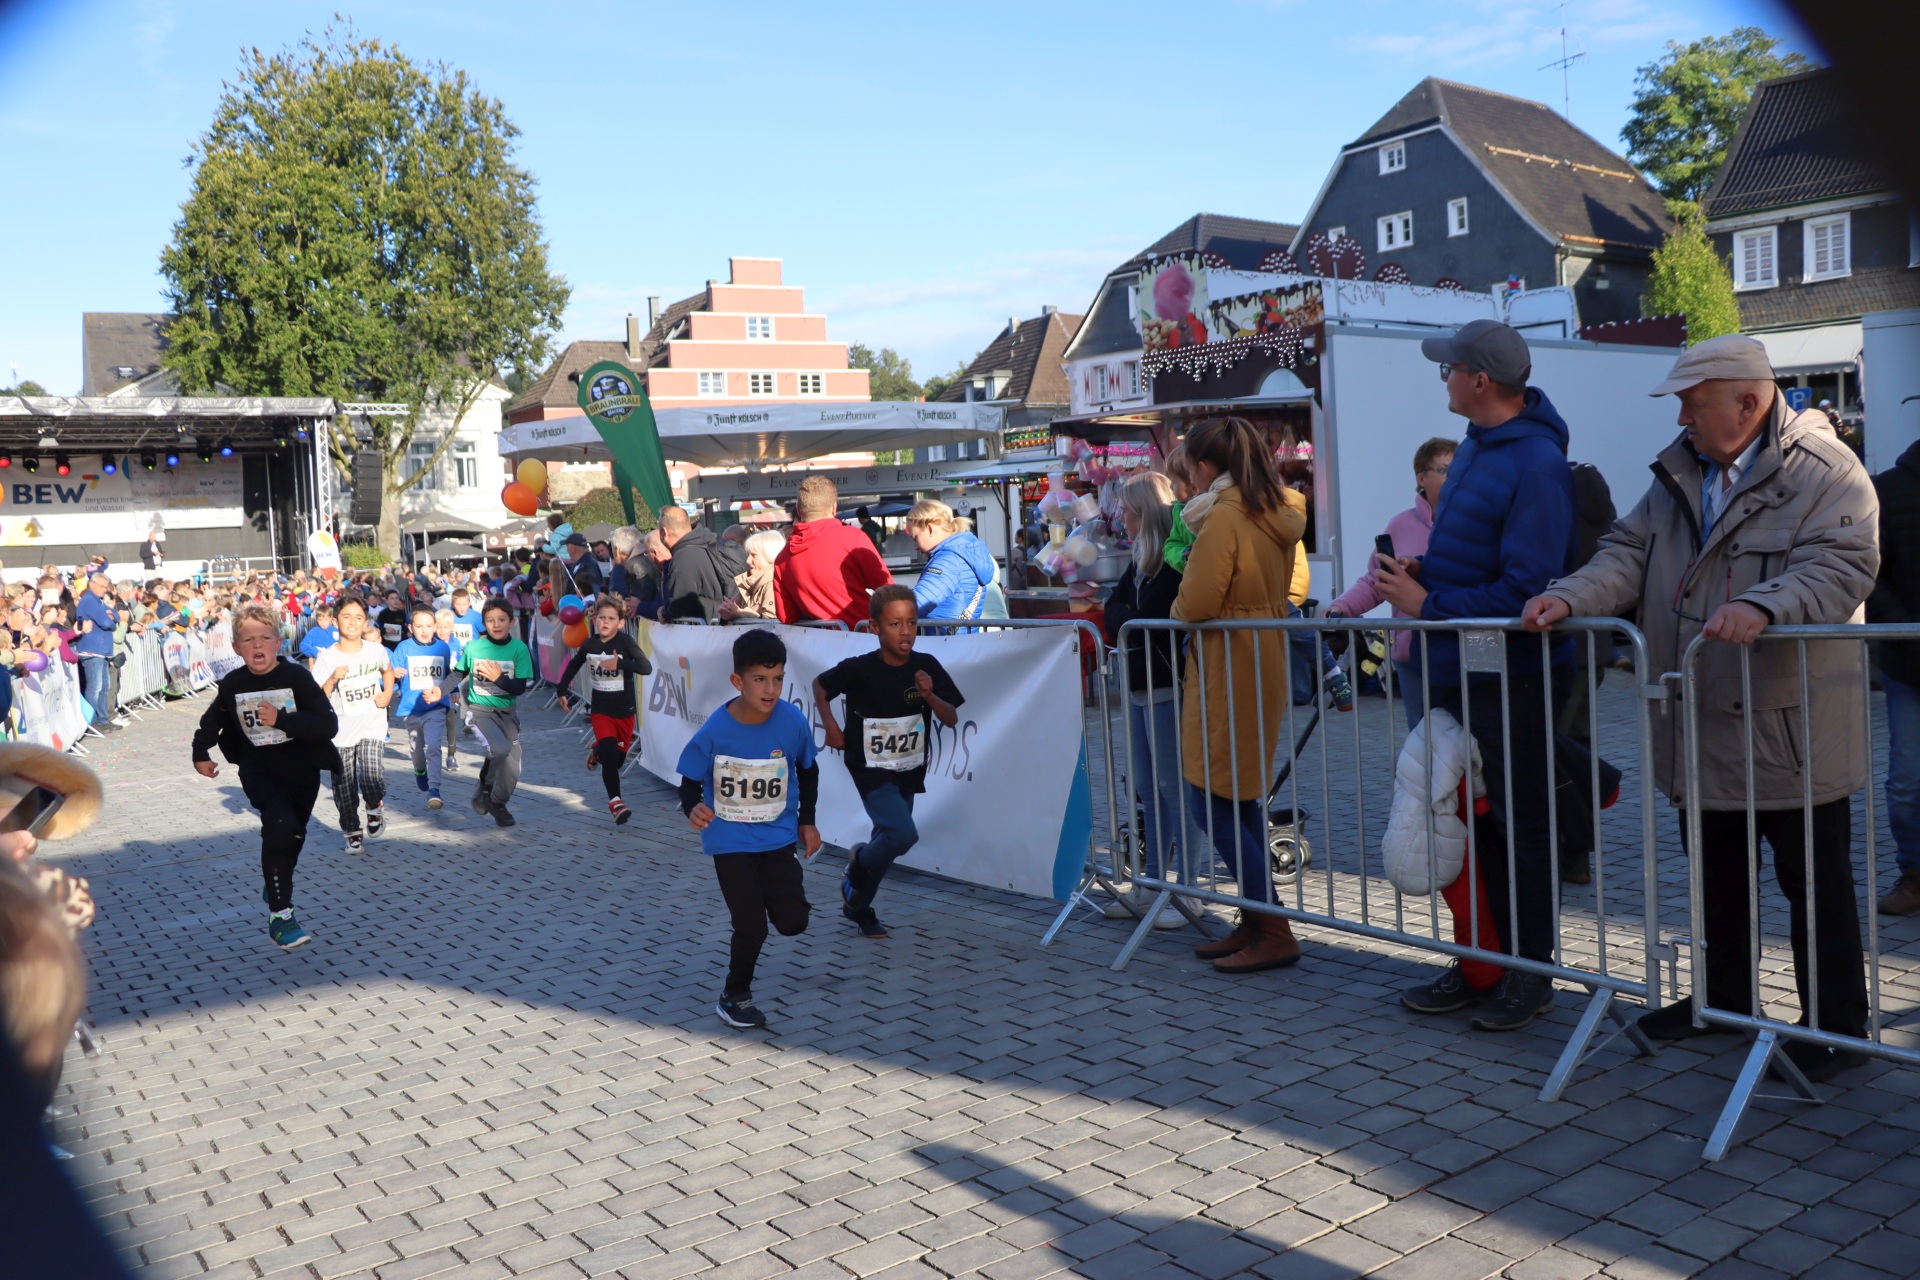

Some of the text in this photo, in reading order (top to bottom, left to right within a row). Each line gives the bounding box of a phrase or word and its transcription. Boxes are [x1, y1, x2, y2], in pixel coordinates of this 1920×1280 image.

[1792, 391, 1806, 410] P
[738, 413, 762, 423] KÖLSCH
[12, 482, 87, 505] BEW
[413, 665, 442, 678] 5320
[345, 683, 376, 703] 5557
[648, 668, 690, 720] BEW
[871, 731, 919, 754] 5427
[720, 776, 782, 799] 5196
